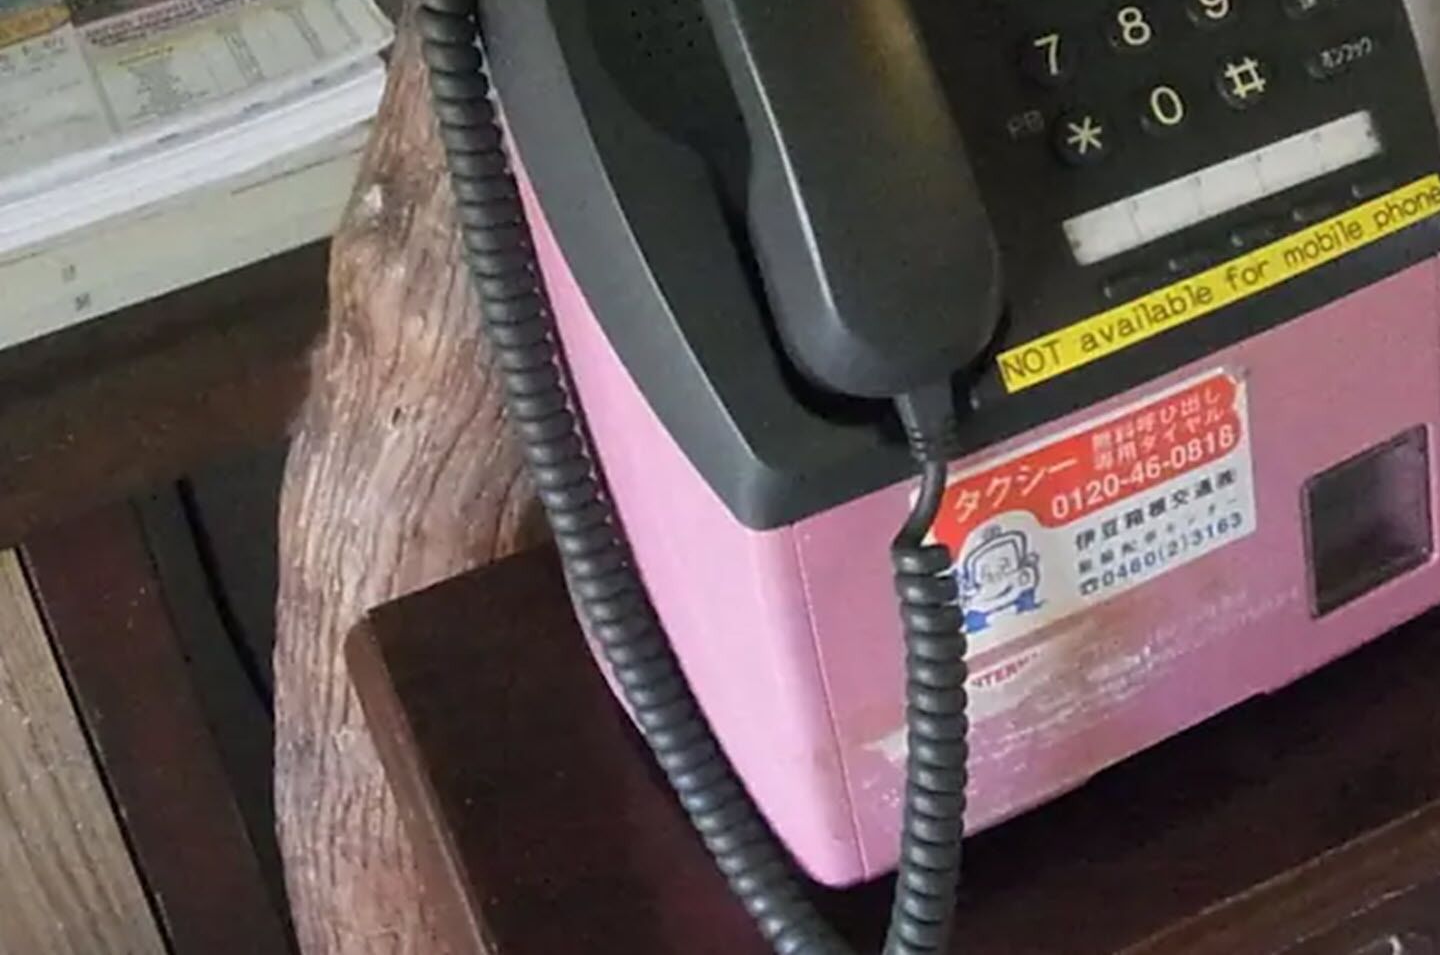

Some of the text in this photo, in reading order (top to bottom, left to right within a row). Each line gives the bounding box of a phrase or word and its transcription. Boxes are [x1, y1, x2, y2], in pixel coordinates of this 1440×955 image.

[1034, 33, 1060, 75] 7
[1117, 6, 1152, 46] 8
[1150, 86, 1184, 125] 0
[1224, 56, 1267, 99] #
[1001, 343, 1061, 384] NOT
[1080, 284, 1214, 352] available
[1224, 258, 1270, 292] for
[1283, 218, 1363, 267] mobile
[954, 456, 1078, 523] タクシー
